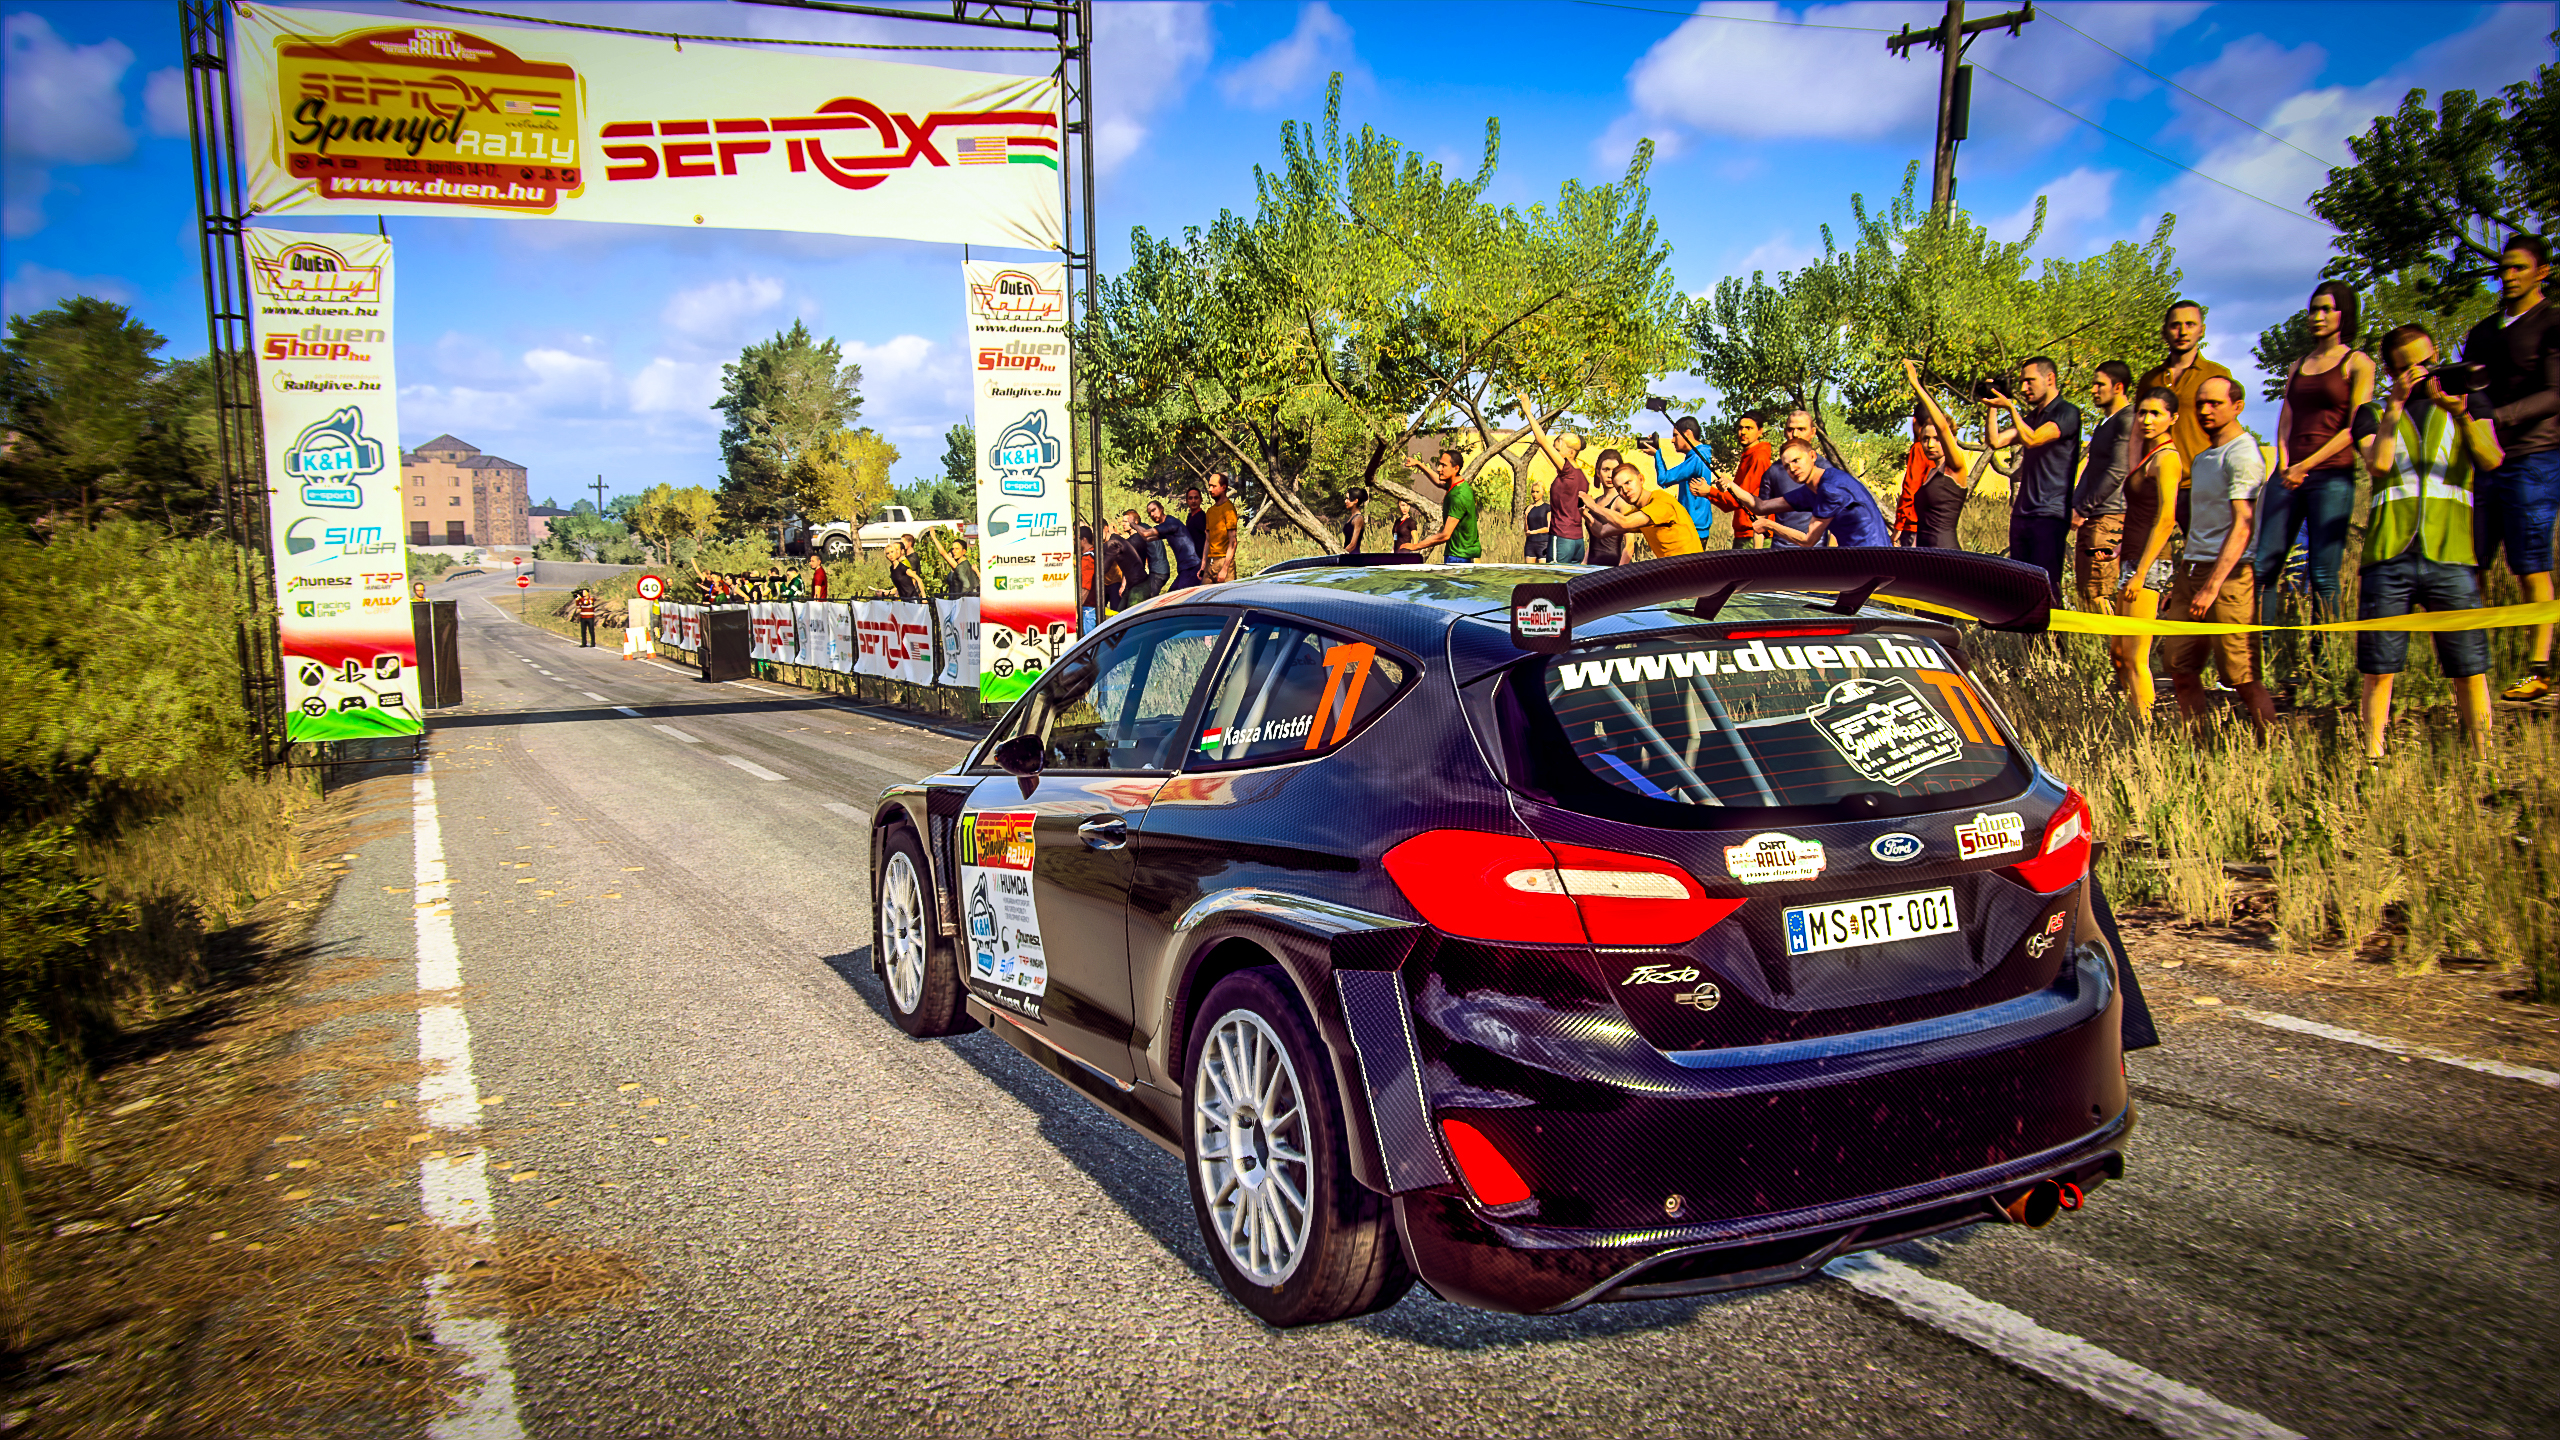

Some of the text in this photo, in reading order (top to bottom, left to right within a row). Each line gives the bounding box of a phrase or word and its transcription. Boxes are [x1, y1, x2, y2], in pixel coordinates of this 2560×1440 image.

[407, 38, 461, 58] RALLY
[300, 73, 561, 119] SEPTOX
[289, 96, 468, 155] Spanyol
[456, 131, 575, 164] Rally
[599, 97, 1057, 190] SEPTOX
[330, 176, 546, 201] www.duen.hu
[290, 253, 337, 272] DuEn
[257, 267, 363, 298] Rally
[1000, 280, 1034, 295] DuEn
[262, 306, 378, 316] www.duen.hu
[975, 292, 1053, 317] Rally
[300, 324, 385, 343] duen
[975, 324, 1062, 333] www.duen.hu
[262, 333, 371, 362] Shop.hu
[1005, 339, 1066, 355] duen
[977, 347, 1056, 371] Shop.hu
[283, 380, 382, 393] Rallylive.hu
[992, 387, 1061, 398] Rallylive.hu
[304, 452, 353, 471] K&H
[1003, 448, 1039, 465] K&H
[308, 491, 353, 499] e-sport
[1006, 482, 1038, 490] e-sport
[996, 555, 1036, 563] hunesz
[1041, 552, 1071, 562] TRP
[299, 576, 353, 586] hunesz
[360, 572, 404, 584] TRP
[1042, 573, 1069, 581] RALLY
[642, 584, 659, 592] 40
[316, 601, 350, 610] racing
[362, 597, 403, 607] RALLY
[317, 609, 336, 617] line
[1531, 612, 1551, 626] RALLY
[1558, 639, 1946, 691] www.duen.hu
[1222, 714, 1313, 747] Kasza Kristóf
[1899, 716, 1946, 742] Rally
[1882, 743, 1952, 777] www.duen.hu
[1978, 816, 2021, 832] duen
[1758, 840, 1787, 850] DiRT
[1883, 838, 1912, 856] Ford
[1958, 827, 2020, 855] Shop.hu
[1006, 846, 1031, 868] Rally
[1755, 850, 1796, 867] RALLY
[1000, 874, 1029, 897] HUMDA
[973, 918, 991, 936] K&H
[1808, 909, 1848, 946] MS
[1792, 934, 1805, 950] H
[1621, 963, 1700, 986] Fiesta
